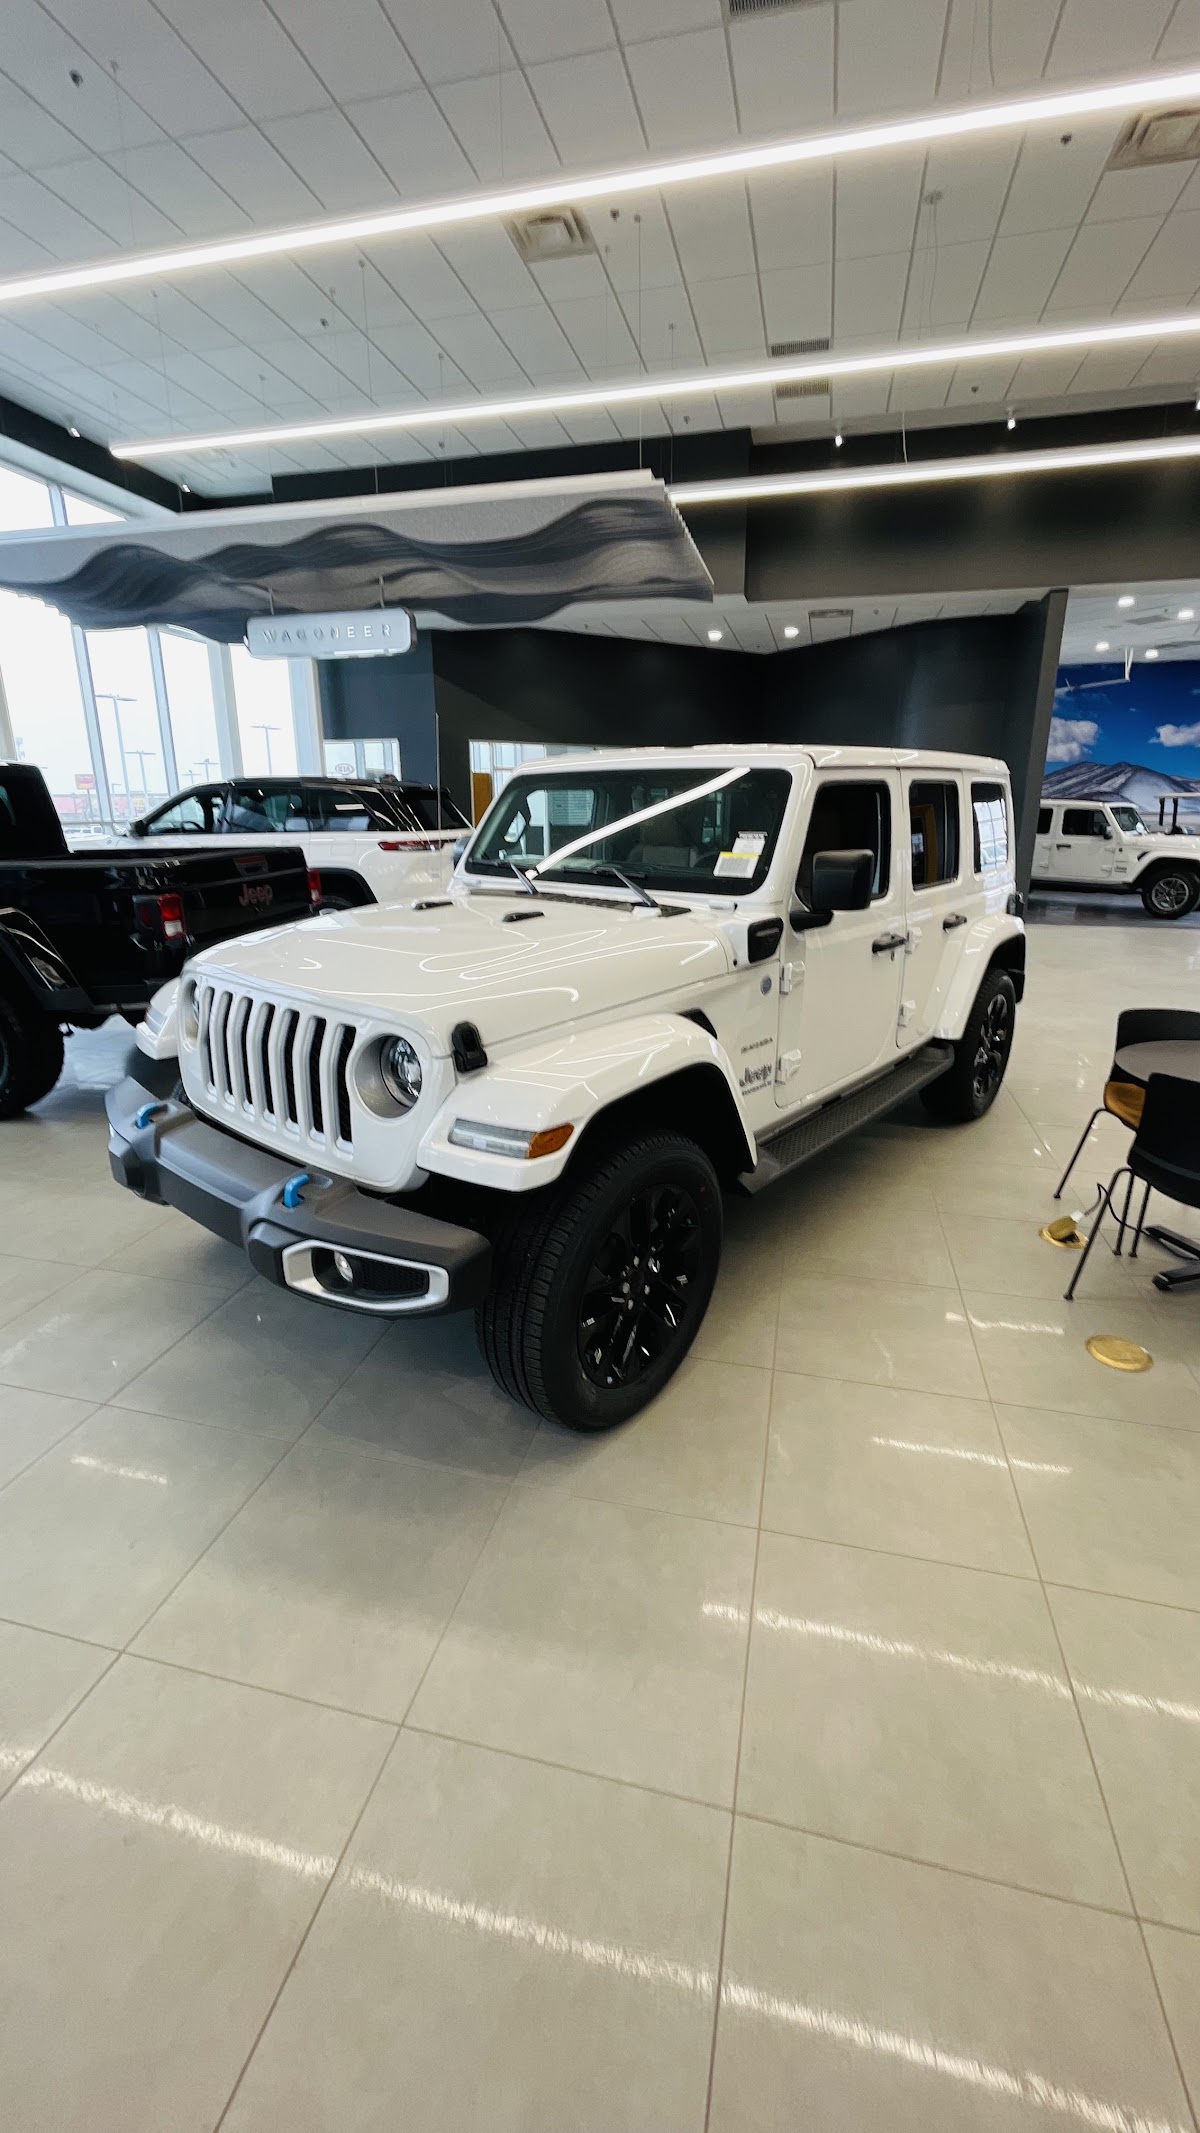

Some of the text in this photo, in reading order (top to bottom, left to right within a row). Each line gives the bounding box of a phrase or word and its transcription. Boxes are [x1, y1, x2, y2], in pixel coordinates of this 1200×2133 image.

[262, 624, 390, 643] WAGONEER
[238, 884, 273, 907] Jeep
[739, 1064, 773, 1087] Jeep
